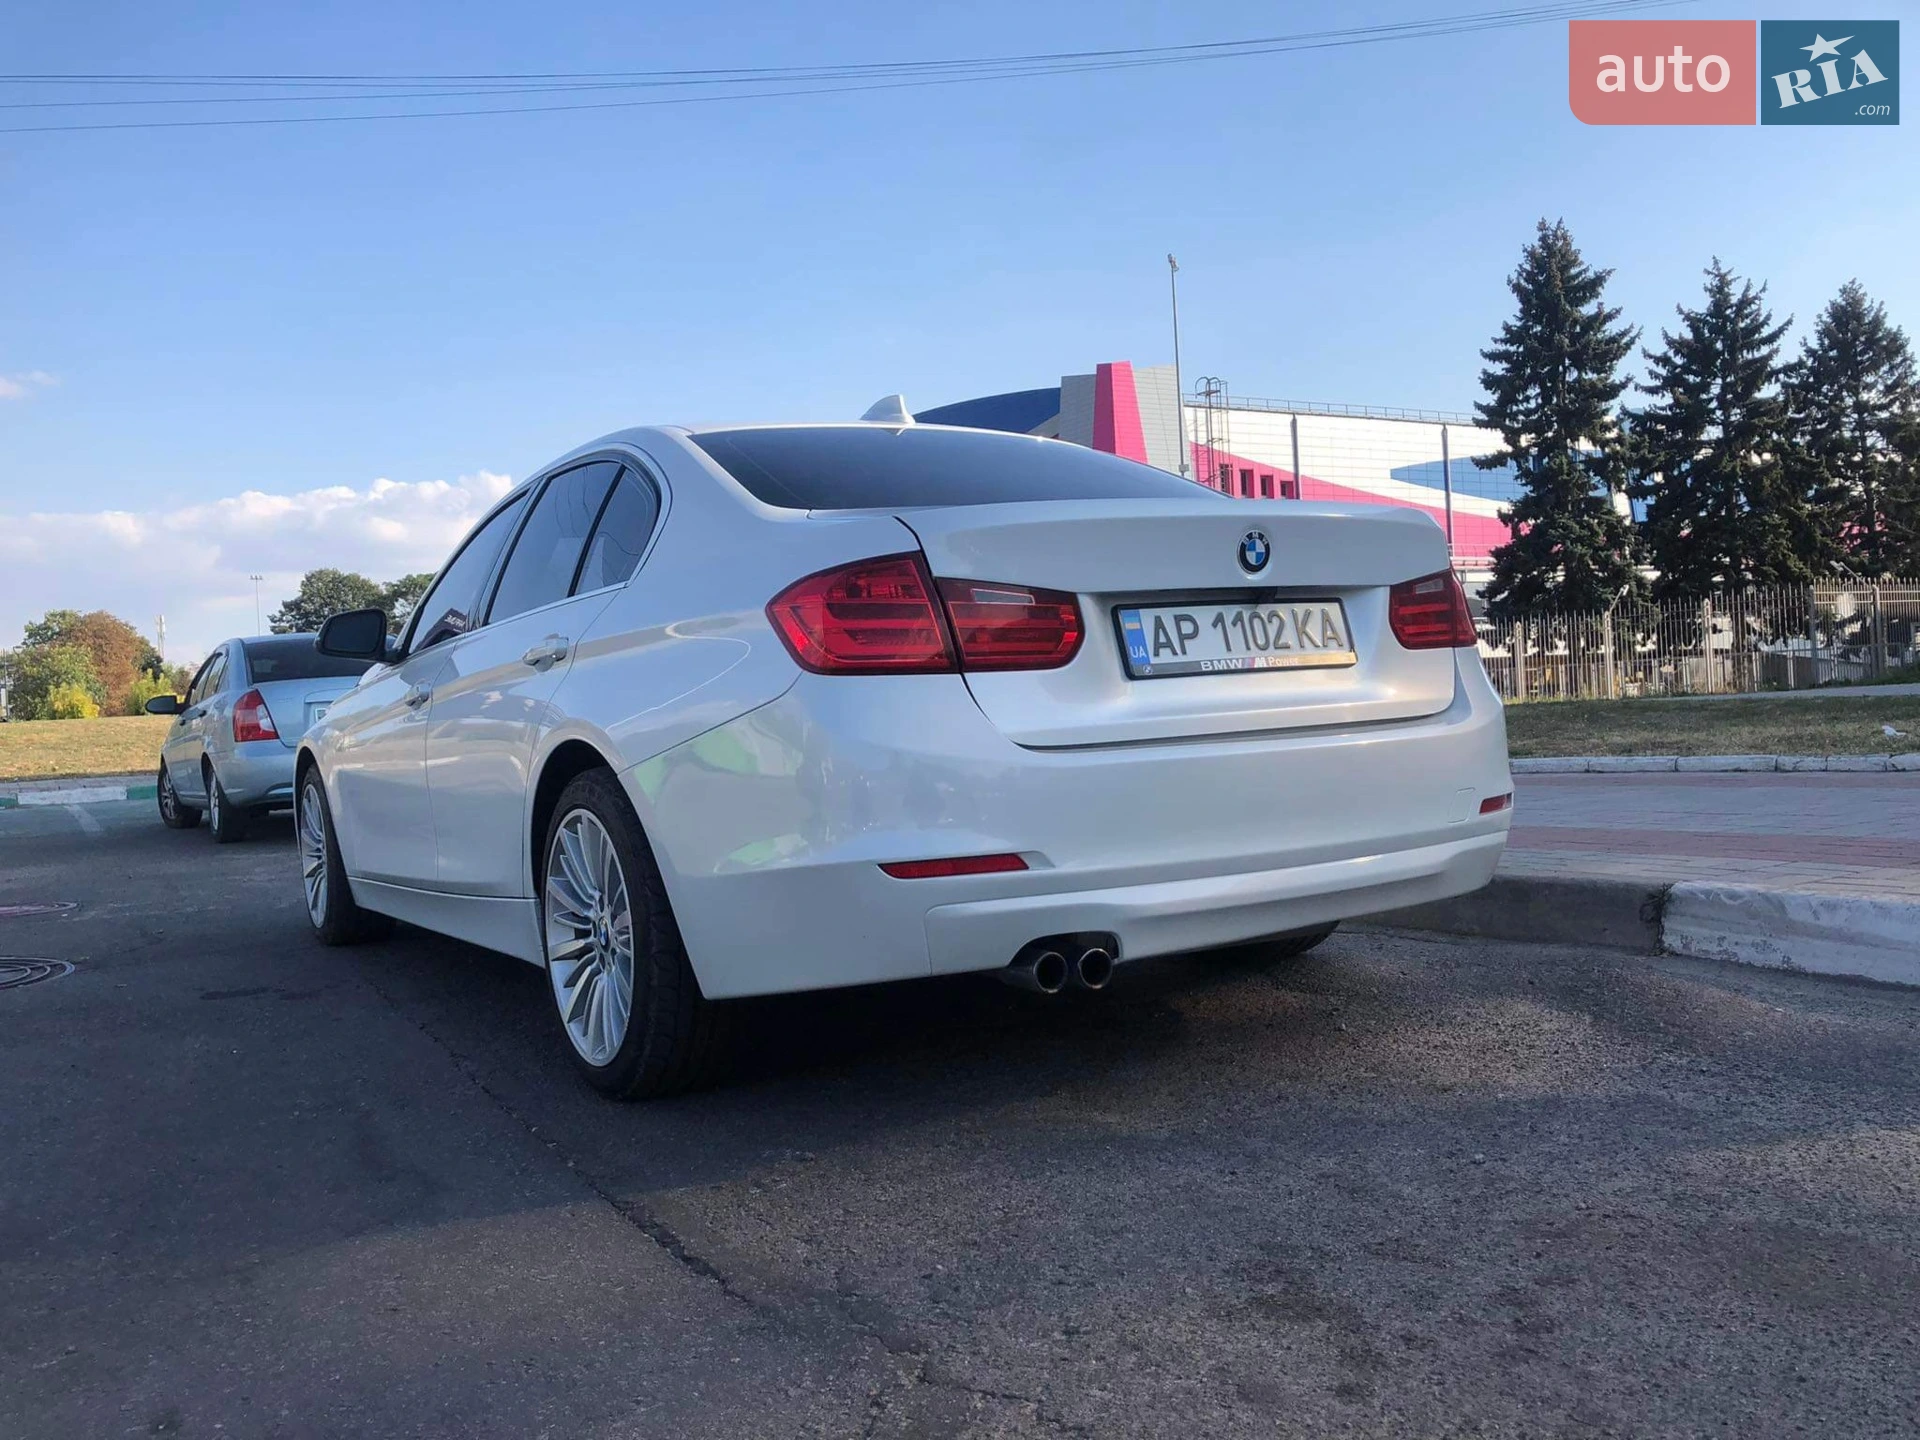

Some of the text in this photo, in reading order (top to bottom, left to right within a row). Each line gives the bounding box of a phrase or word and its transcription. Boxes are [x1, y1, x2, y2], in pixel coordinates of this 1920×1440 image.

[1243, 531, 1269, 545] BMW
[1211, 609, 1291, 652] 1102
[1292, 607, 1343, 648] KA
[1130, 646, 1147, 658] UA
[1200, 658, 1243, 671] BMW
[1268, 656, 1298, 666] Power
